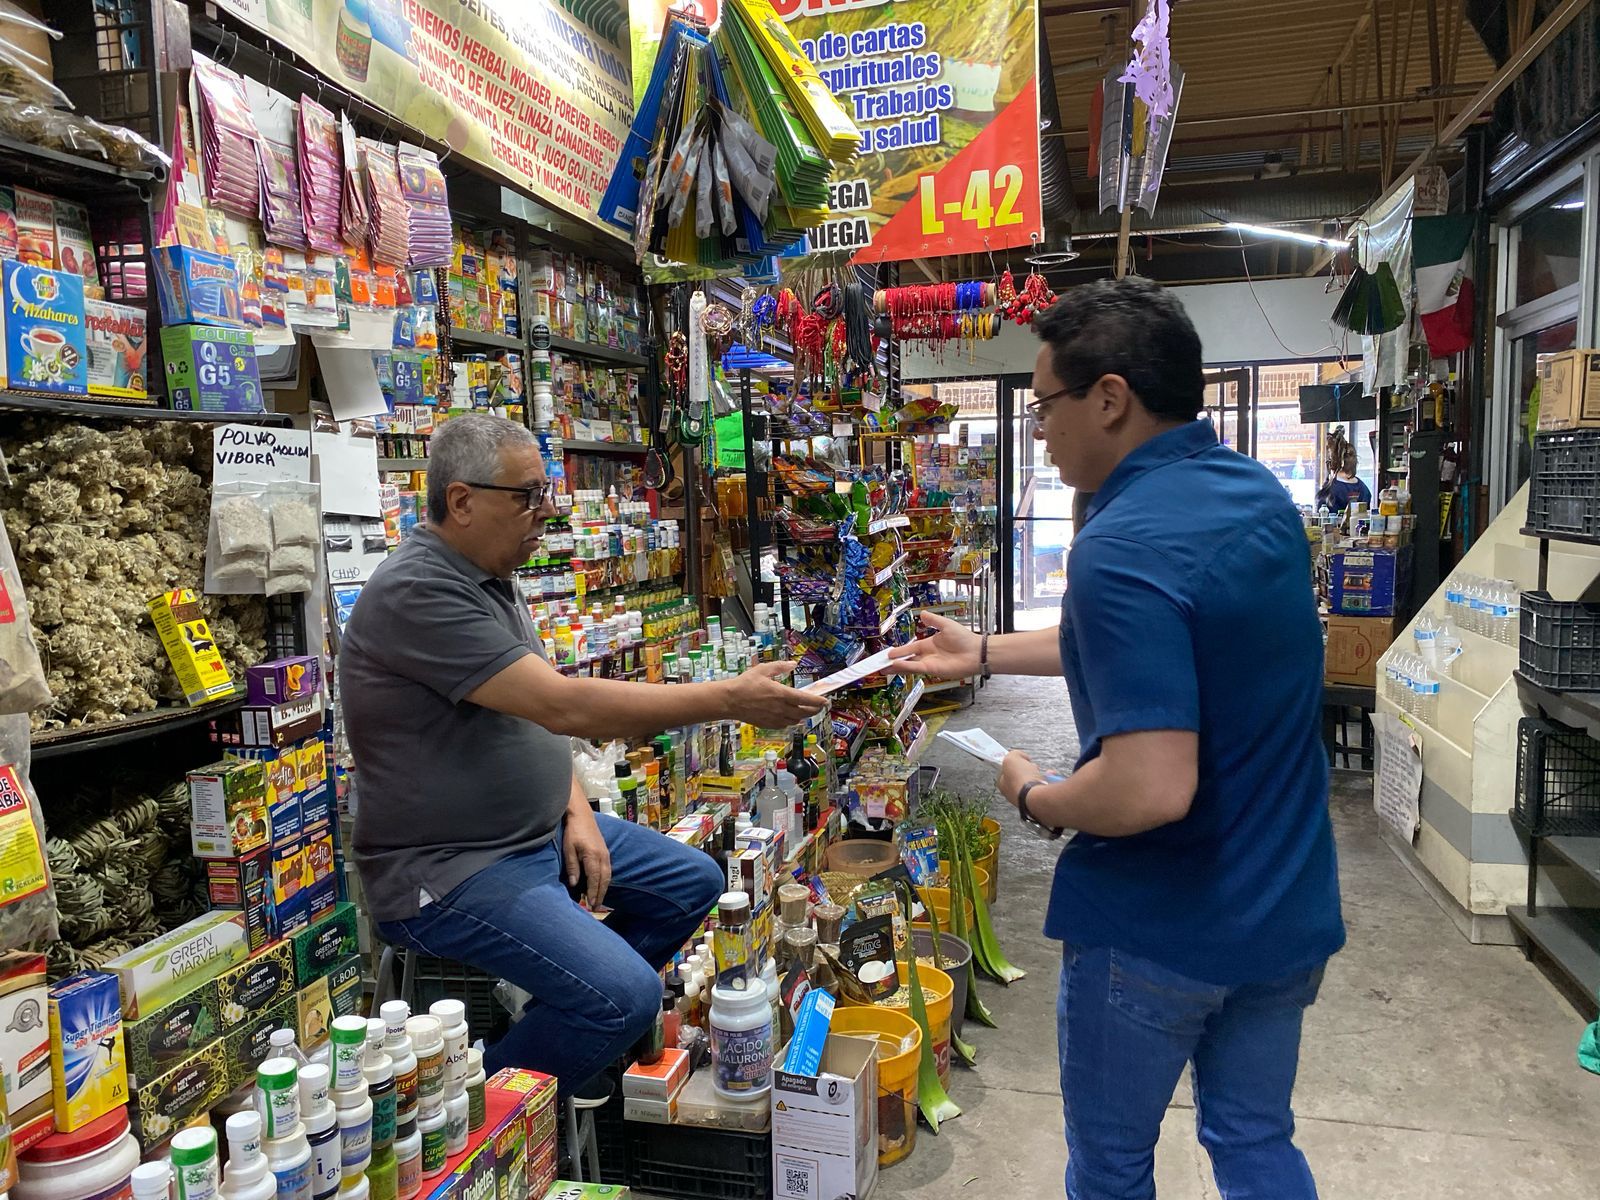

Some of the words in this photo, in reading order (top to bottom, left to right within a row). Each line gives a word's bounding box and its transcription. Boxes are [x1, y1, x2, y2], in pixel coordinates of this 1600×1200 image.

[819, 33, 848, 60] de
[851, 24, 925, 54] cartas
[402, 0, 461, 52] TENEMOS
[461, 35, 508, 82] HERBAL
[509, 65, 553, 115] WONDER,
[554, 95, 593, 140] FOREVER,
[593, 122, 621, 155] ENERGY
[411, 30, 466, 86] SHAMPOO
[468, 69, 484, 97] DE
[484, 80, 517, 121] NUEZ,
[518, 101, 554, 138] LINAZA
[819, 54, 940, 92] spirituales
[577, 77, 617, 120] ARCILLA,
[595, 75, 635, 112] HIERBAS
[853, 84, 952, 120] Trabajos
[419, 60, 450, 98] JUGO
[503, 119, 541, 162] KINLAX,
[541, 143, 567, 172] JUGO
[876, 115, 938, 149] salud
[490, 136, 535, 179] CEREALES
[535, 163, 542, 184] Y
[543, 168, 573, 201] MUCHO
[573, 186, 593, 211] MAS.
[922, 165, 1024, 236] L-42
[25, 302, 79, 326] Azahares
[85, 314, 145, 337] rostaMax
[196, 327, 248, 343] COLITIS
[200, 341, 218, 365] Q
[199, 363, 231, 387] G5
[396, 374, 411, 388] G5
[175, 400, 190, 410] G5
[395, 407, 413, 425] GOJI
[219, 428, 276, 447] POLVO
[216, 451, 276, 467] VIBORA
[272, 445, 309, 458] MOLIDA
[170, 933, 213, 965] GREEN
[315, 942, 332, 957] GREEN
[332, 936, 342, 946] TEA
[852, 938, 882, 955] Zinc
[171, 945, 220, 980] MARVEL
[250, 967, 269, 979] MEYERS
[250, 976, 261, 985] HILL
[266, 976, 276, 984] TEA
[332, 966, 357, 988] T-BOD
[169, 1009, 190, 1025] MEYERS
[181, 1023, 192, 1034] TEA
[65, 1026, 90, 1044] Super
[89, 1014, 120, 1032] Tiamina
[196, 1080, 207, 1090] TEA
[781, 1075, 807, 1086] Apagado
[463, 1166, 494, 1200] Diabetes
